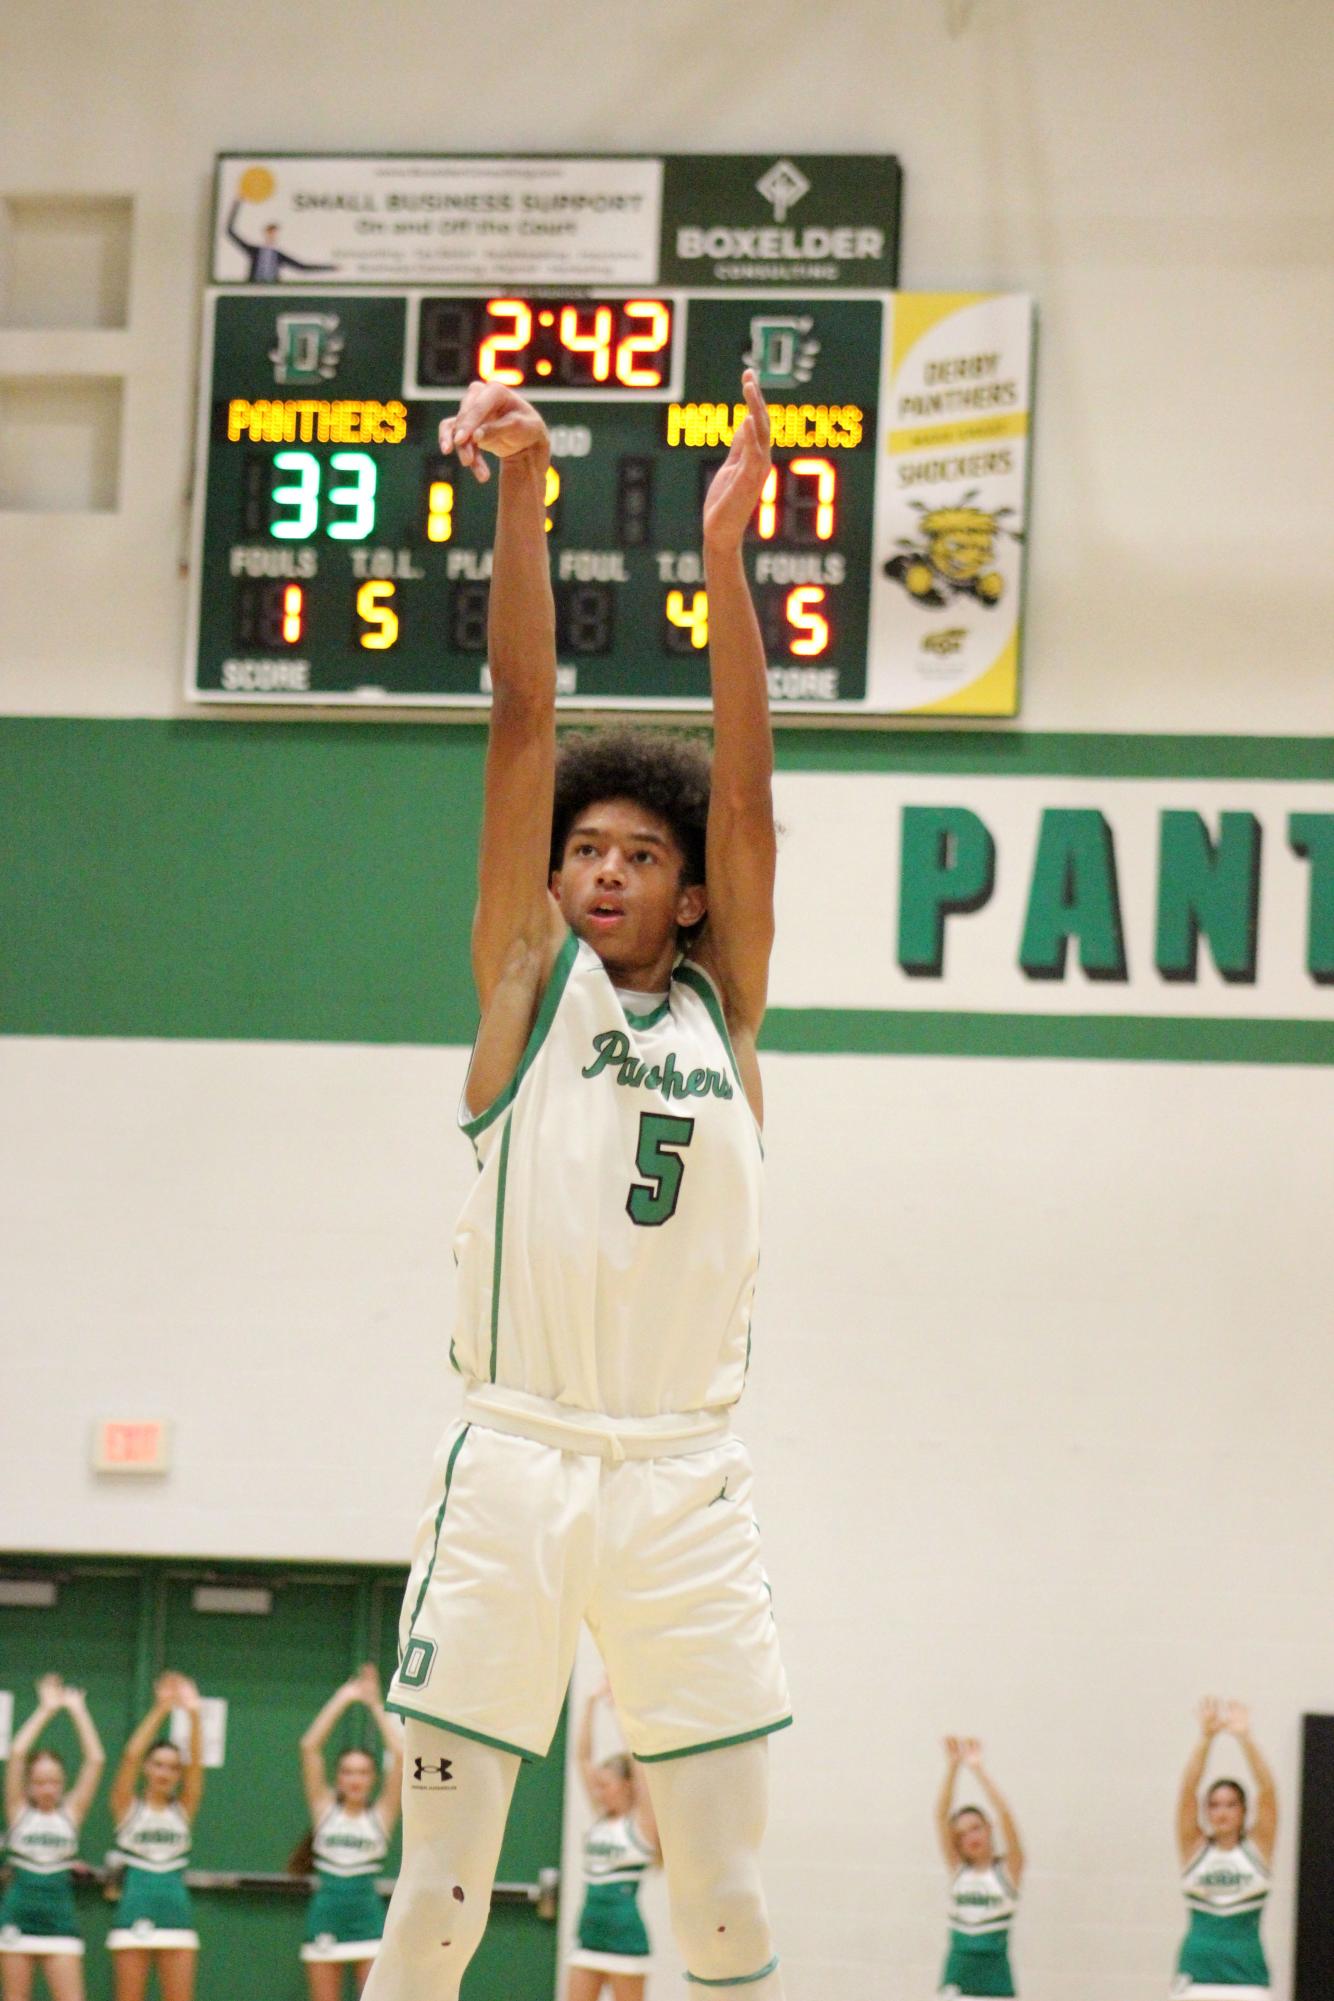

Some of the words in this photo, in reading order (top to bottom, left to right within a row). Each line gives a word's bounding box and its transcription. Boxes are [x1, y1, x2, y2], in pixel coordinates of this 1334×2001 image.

[386, 192, 512, 212] BUSINESS
[520, 193, 643, 213] SUPPORT
[676, 227, 885, 260] BOXELDER
[478, 299, 671, 388] 2:42
[924, 354, 1000, 386] DERBY
[898, 381, 1017, 417] PANTHERS
[227, 399, 408, 443] PANTHERS
[667, 402, 863, 448] MAVRICKS
[898, 449, 1012, 488] SHOCKERS
[270, 451, 377, 540] 33
[757, 456, 836, 541] 17
[229, 547, 318, 578] FOULS
[755, 552, 846, 585] FOULS
[356, 580, 399, 650] 5
[666, 590, 709, 649] 4
[787, 585, 829, 656] 5
[222, 658, 310, 691] SCORE
[767, 667, 838, 699] CORE
[625, 1111, 695, 1227] 5
